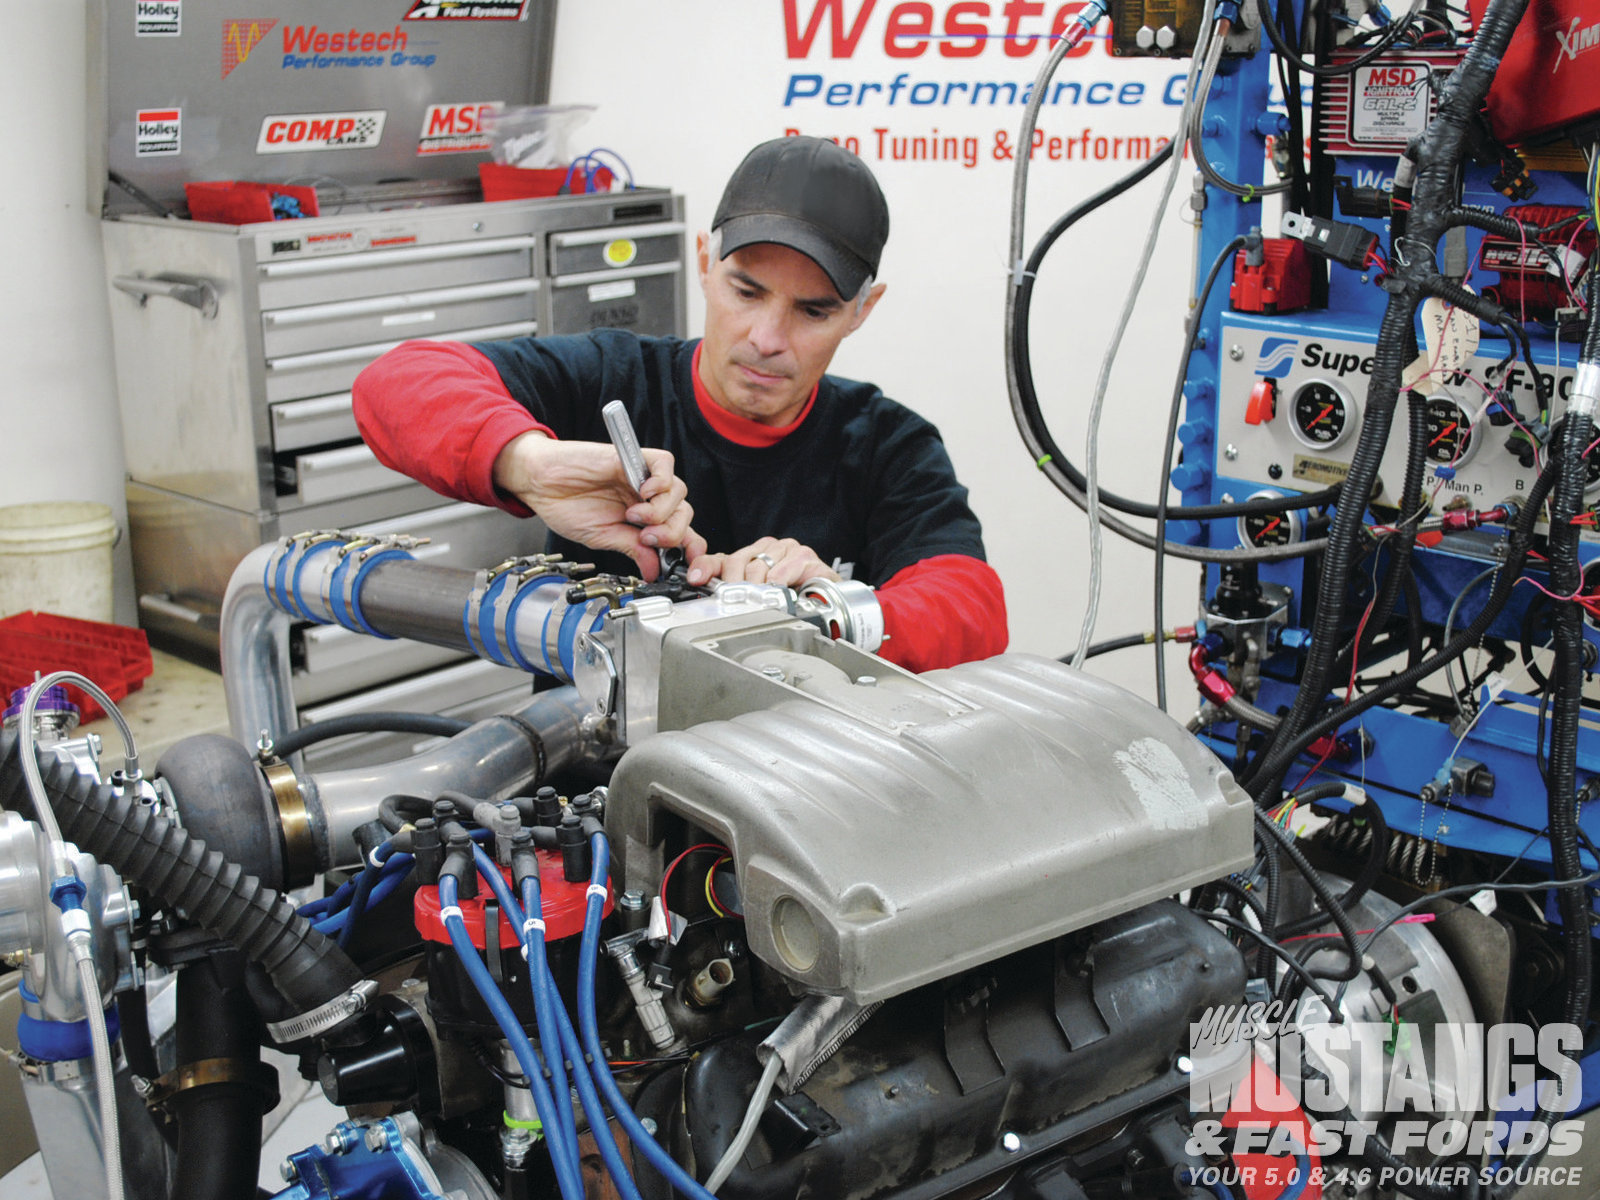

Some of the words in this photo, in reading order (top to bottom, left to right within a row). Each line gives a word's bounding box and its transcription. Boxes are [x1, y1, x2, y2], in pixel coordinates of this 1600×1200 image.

[138, 4, 178, 19] Holley
[443, 6, 471, 17] Fuel
[782, 0, 1113, 58] Weste
[283, 25, 408, 53] Westech
[282, 54, 384, 69] Performance
[391, 52, 436, 67] Group
[1368, 68, 1416, 87] MSD
[1363, 97, 1417, 111] 6AL-2
[138, 124, 179, 137] Holley
[266, 118, 355, 144] COMP
[874, 127, 978, 168] Tuning
[993, 129, 1014, 160] &
[1444, 479, 1470, 493] Man
